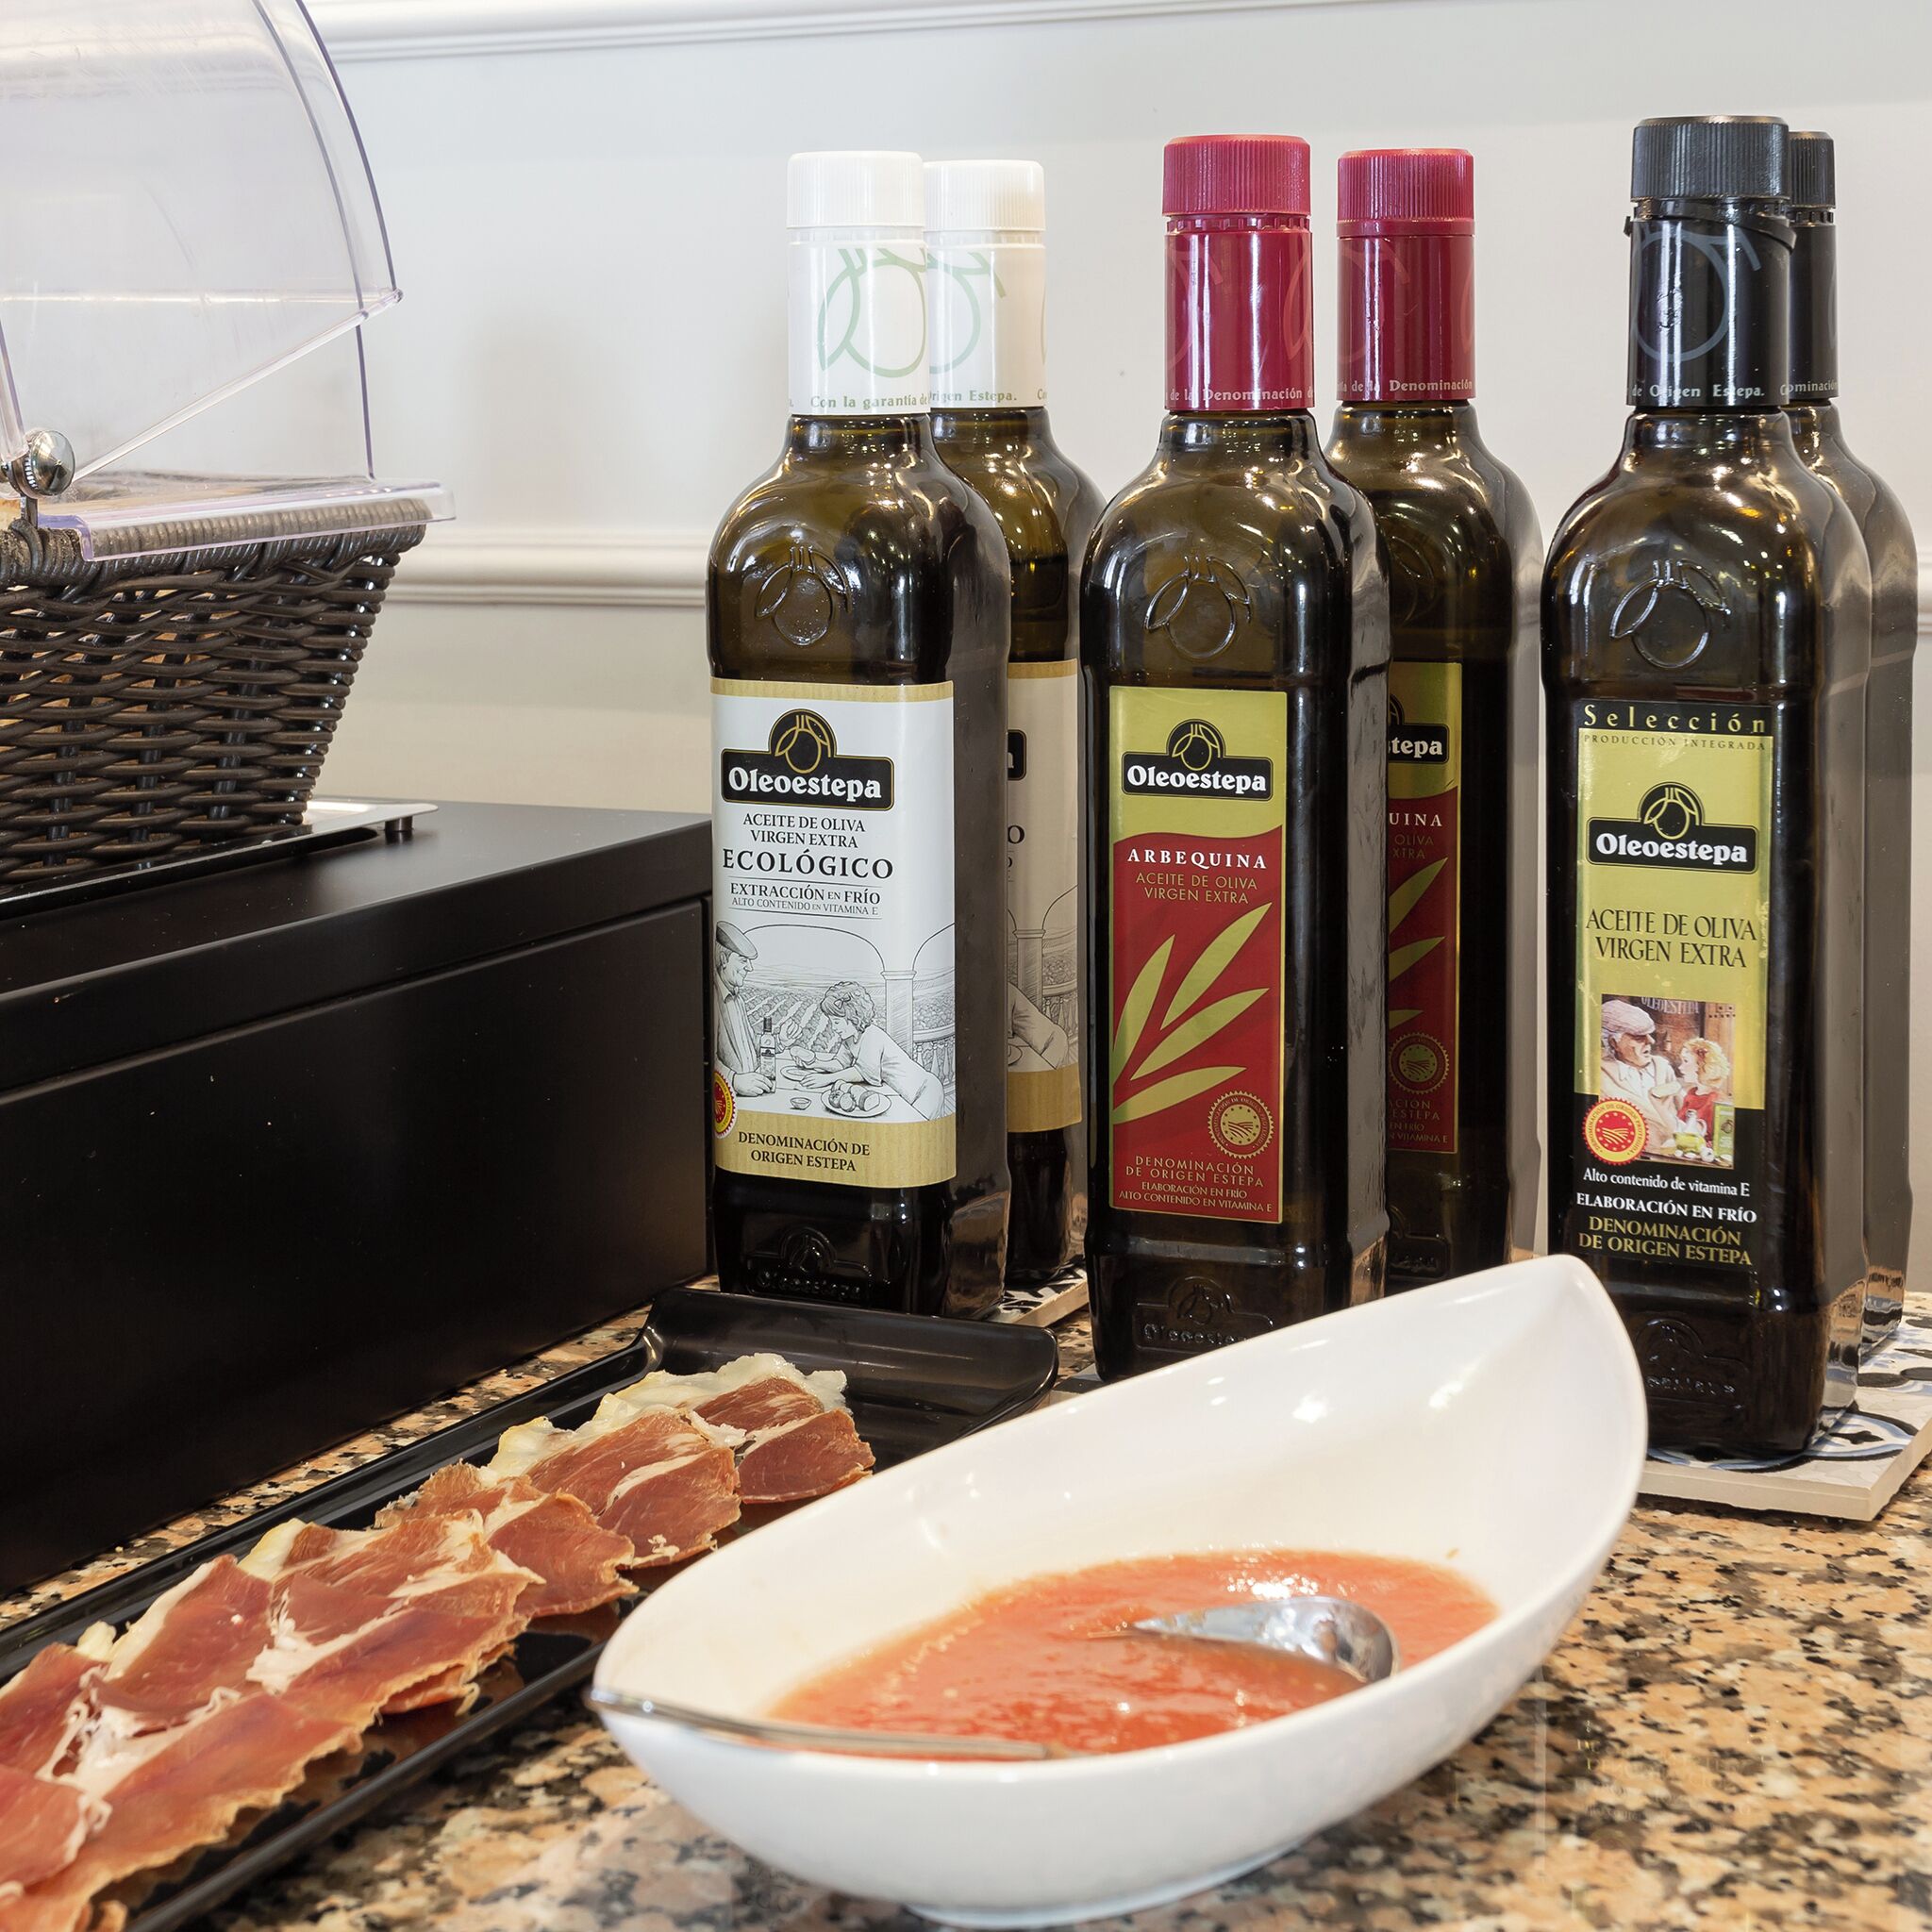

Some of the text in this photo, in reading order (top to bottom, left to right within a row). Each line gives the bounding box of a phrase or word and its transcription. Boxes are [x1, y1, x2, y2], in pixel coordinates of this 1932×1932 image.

[1170, 389, 1180, 400] de
[1351, 380, 1364, 392] de
[1390, 379, 1473, 392] Denominación
[810, 395, 837, 408] Con
[843, 394, 857, 408] la
[863, 393, 917, 409] garantía
[929, 390, 962, 404] rigen
[969, 390, 1017, 404] Estepa.
[1584, 704, 1765, 733] Selección
[1584, 734, 1766, 751] PRODUCCIÓN INTEGRADA
[728, 766, 882, 802] Oleoestepa
[1127, 765, 1267, 794] Oleoestepa
[743, 813, 866, 832] ACEITE DE OLIVA
[751, 830, 858, 848] VIRGEN EXTRA
[1596, 832, 1747, 866] Oleoestepa
[723, 849, 893, 879] ECOLÓGICO
[1127, 849, 1266, 870] ARBEQUINA
[1136, 872, 1257, 891] ACEITE DE OLIVA
[730, 883, 880, 905] EXTRACCIÓN EN FRÍO
[1144, 887, 1249, 904] VIRGEN EXTRA
[732, 897, 755, 907] ALTO
[757, 898, 811, 911] CONTENIDO
[823, 904, 869, 915] VITAMINA
[872, 907, 878, 915] E
[1586, 908, 1757, 941] ACEITE DE OLIVA
[1595, 936, 1747, 968] VIRGEN EXTRA
[738, 1130, 870, 1157] DENOMINACIÓN DE
[1442, 1135, 1449, 1143] E
[751, 1149, 857, 1172] ORIGEN ESTEPA
[1136, 1156, 1254, 1175] DENOMINACIÓN
[1126, 1166, 1264, 1188] DE ORIGEN ESTEPA
[1583, 1168, 1750, 1197] Alto contenido de vitamina E
[1141, 1181, 1247, 1200] ELABORACIÓN EN FRÍO
[1119, 1191, 1272, 1213] ALTO CONTENIDO EN VITAMINA E
[1576, 1192, 1757, 1224] ELABORACIÓN EN FRÍO
[1589, 1216, 1741, 1246] DENOMINACIÓN
[1579, 1233, 1752, 1266] DE ORIGEN ESTEPA
